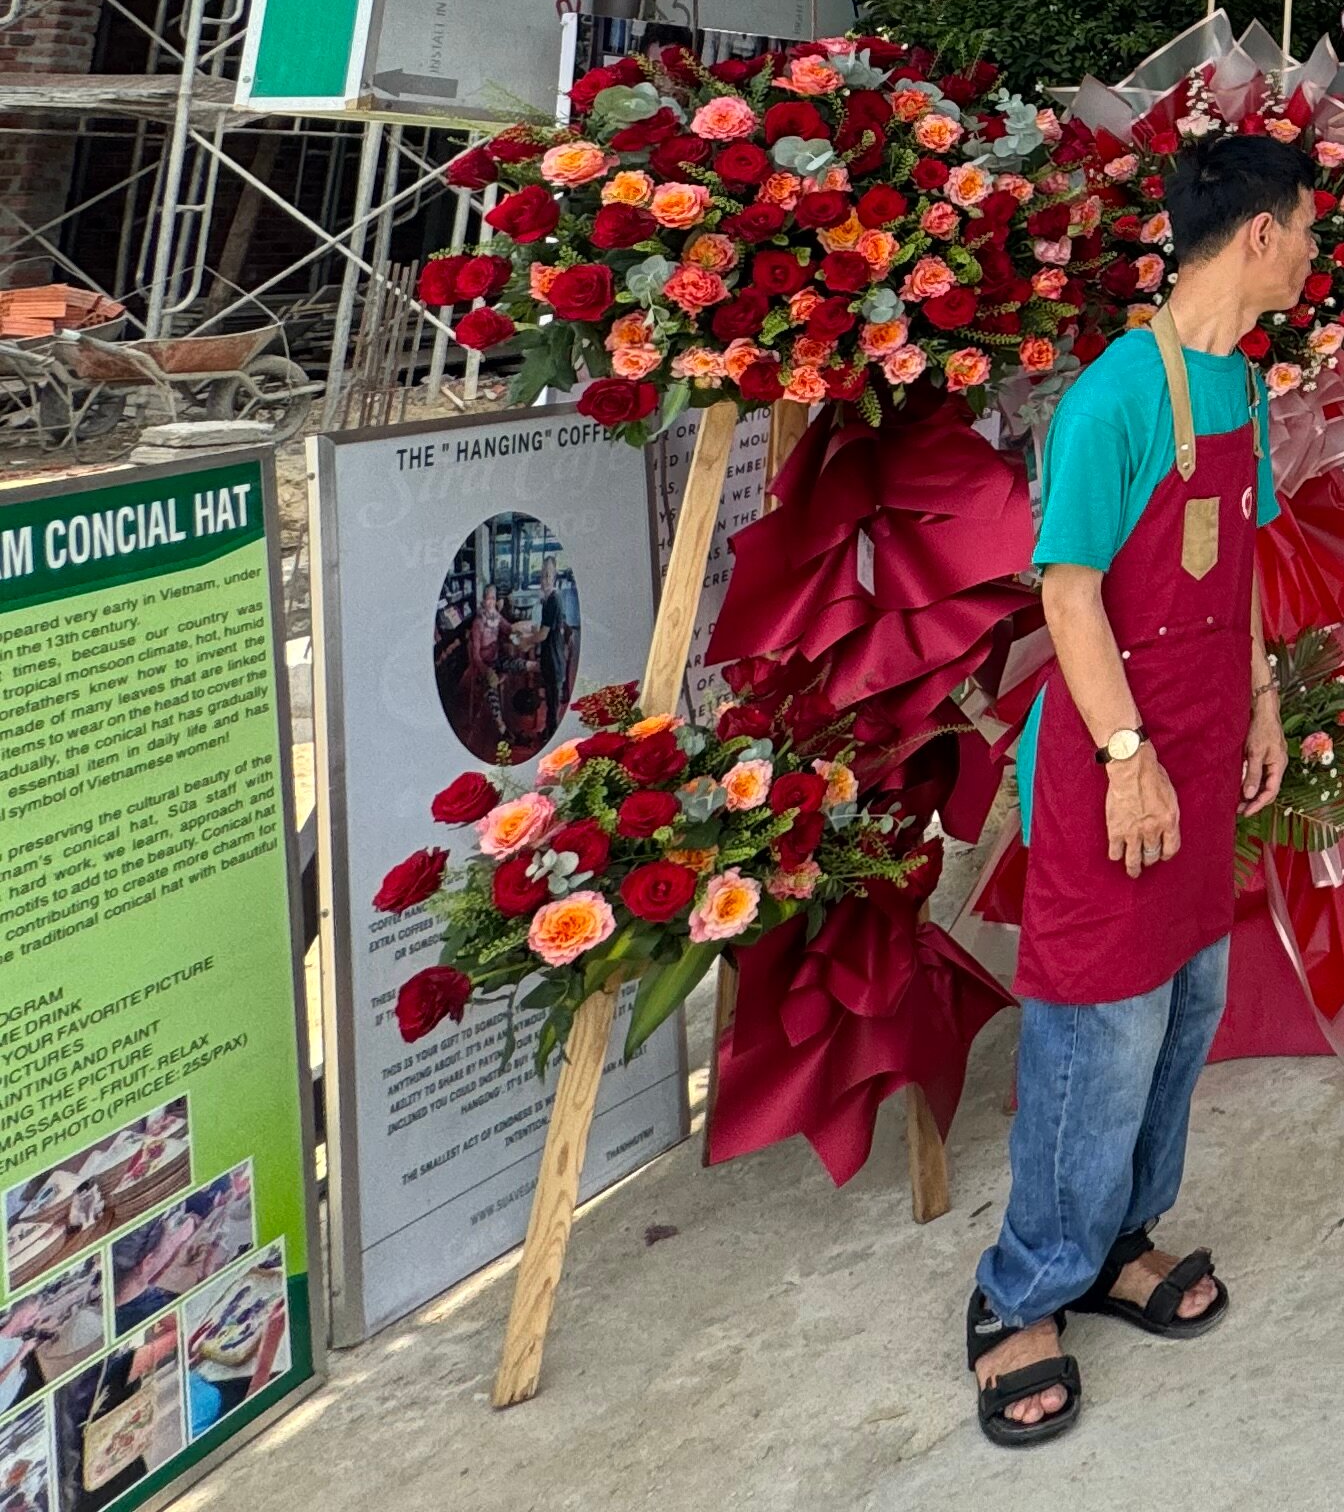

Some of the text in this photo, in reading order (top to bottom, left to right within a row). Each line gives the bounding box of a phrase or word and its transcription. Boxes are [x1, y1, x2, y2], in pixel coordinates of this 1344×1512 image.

[396, 444, 434, 470] THE
[558, 421, 611, 448] COFFE
[45, 498, 186, 570] CONCIAL
[194, 484, 250, 537] HAT
[0, 568, 261, 644] peared very early in Vietnam, under
[13, 601, 262, 678] times, because our country was
[17, 641, 40, 657] the
[46, 629, 78, 649] 13th
[81, 617, 139, 640] century.
[0, 635, 264, 721] orefathers knew how to invent the
[3, 616, 264, 700] tropical monsoon climate, hot, humid
[8, 702, 269, 797] essential item in daily life and has
[63, 825, 119, 858] conical
[129, 813, 158, 833] hat,
[206, 782, 236, 804] staff
[246, 769, 272, 789] with
[6, 822, 276, 941] contributing to create more charm for
[3, 955, 214, 1066] YOUR FAVORITE PICTURE
[71, 1019, 160, 1075] AND PAINT
[42, 1108, 104, 1153] PHOTO
